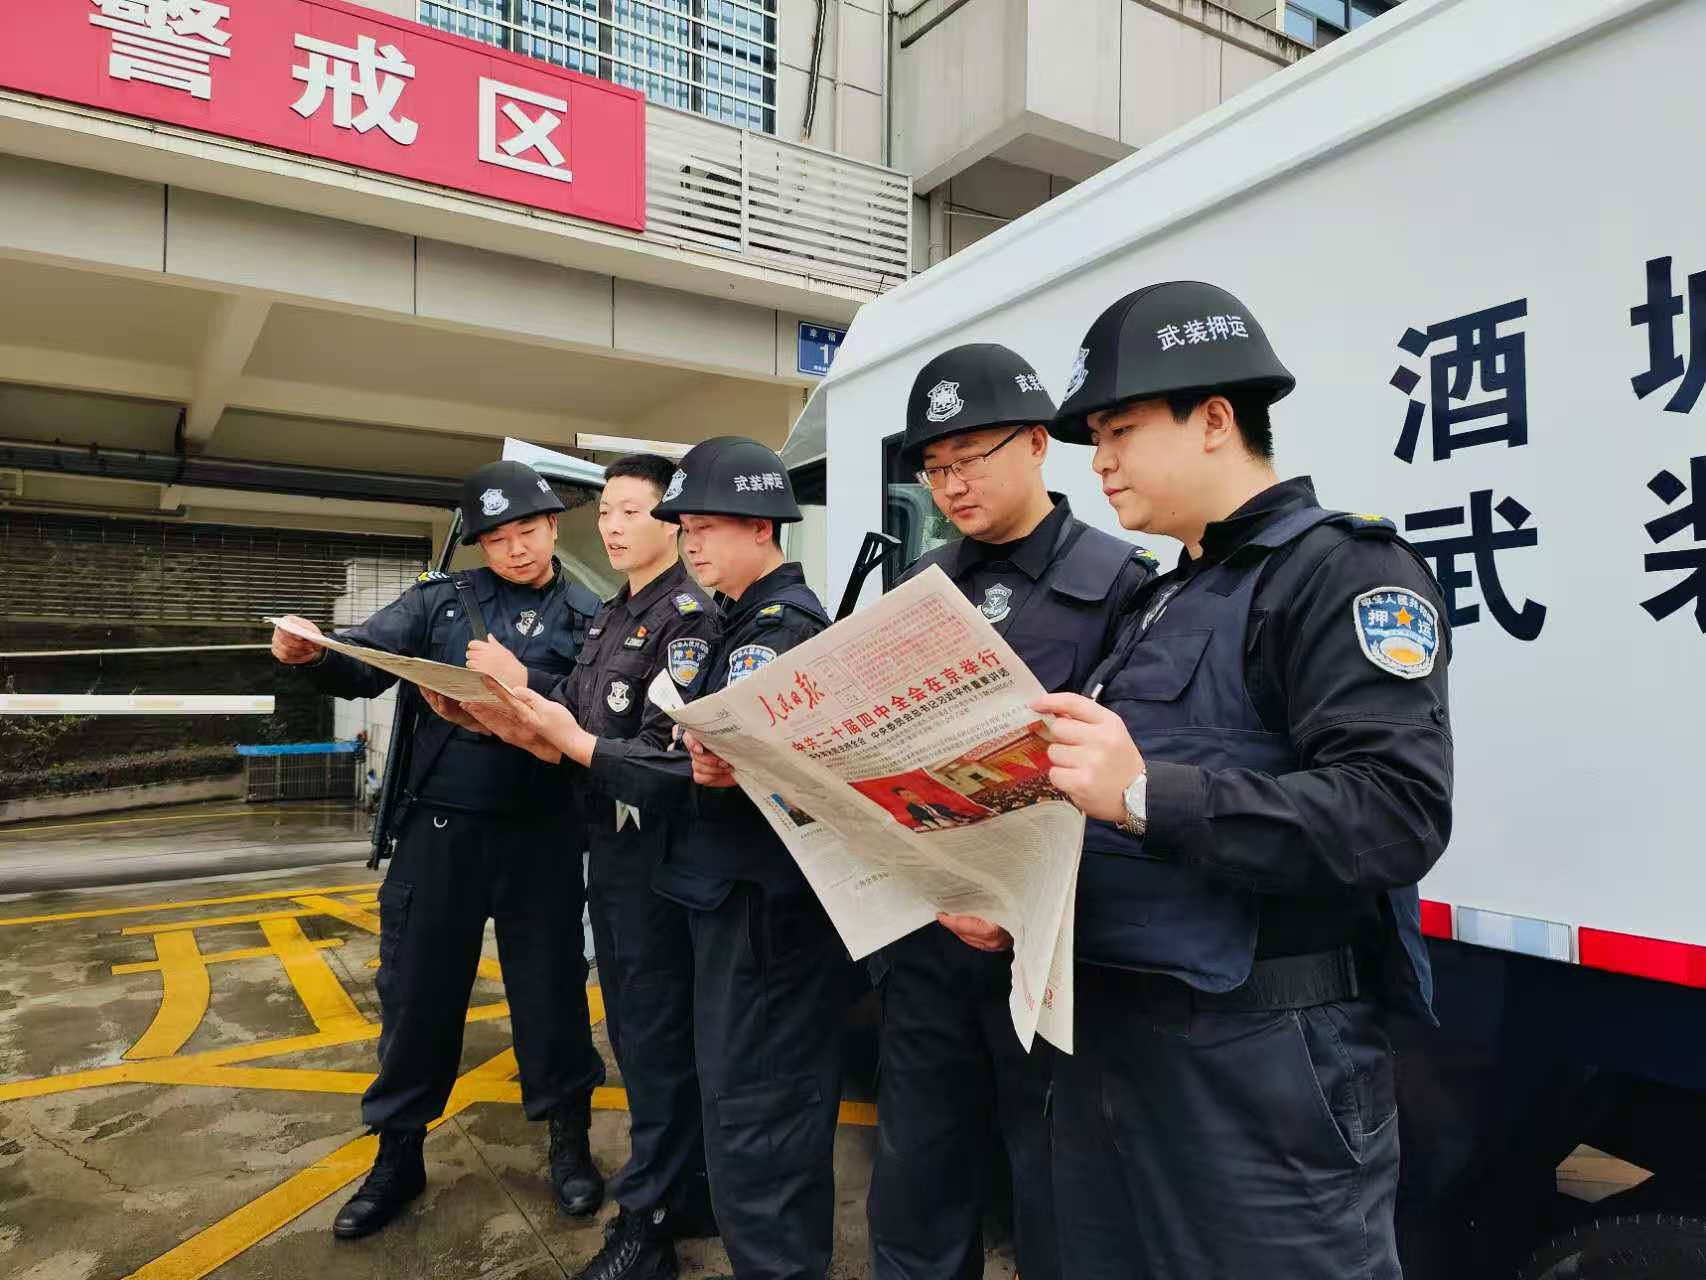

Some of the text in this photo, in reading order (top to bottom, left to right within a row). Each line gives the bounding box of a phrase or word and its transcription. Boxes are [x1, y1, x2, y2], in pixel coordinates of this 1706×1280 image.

[89, 0, 573, 183] 警戒区
[1157, 315, 1249, 351] 武装押运
[1014, 372, 1048, 393] 武装
[733, 471, 785, 492] 武装押运
[757, 671, 826, 727] 人民日报
[791, 648, 1001, 754] 中共二十届四中全会在京举行
